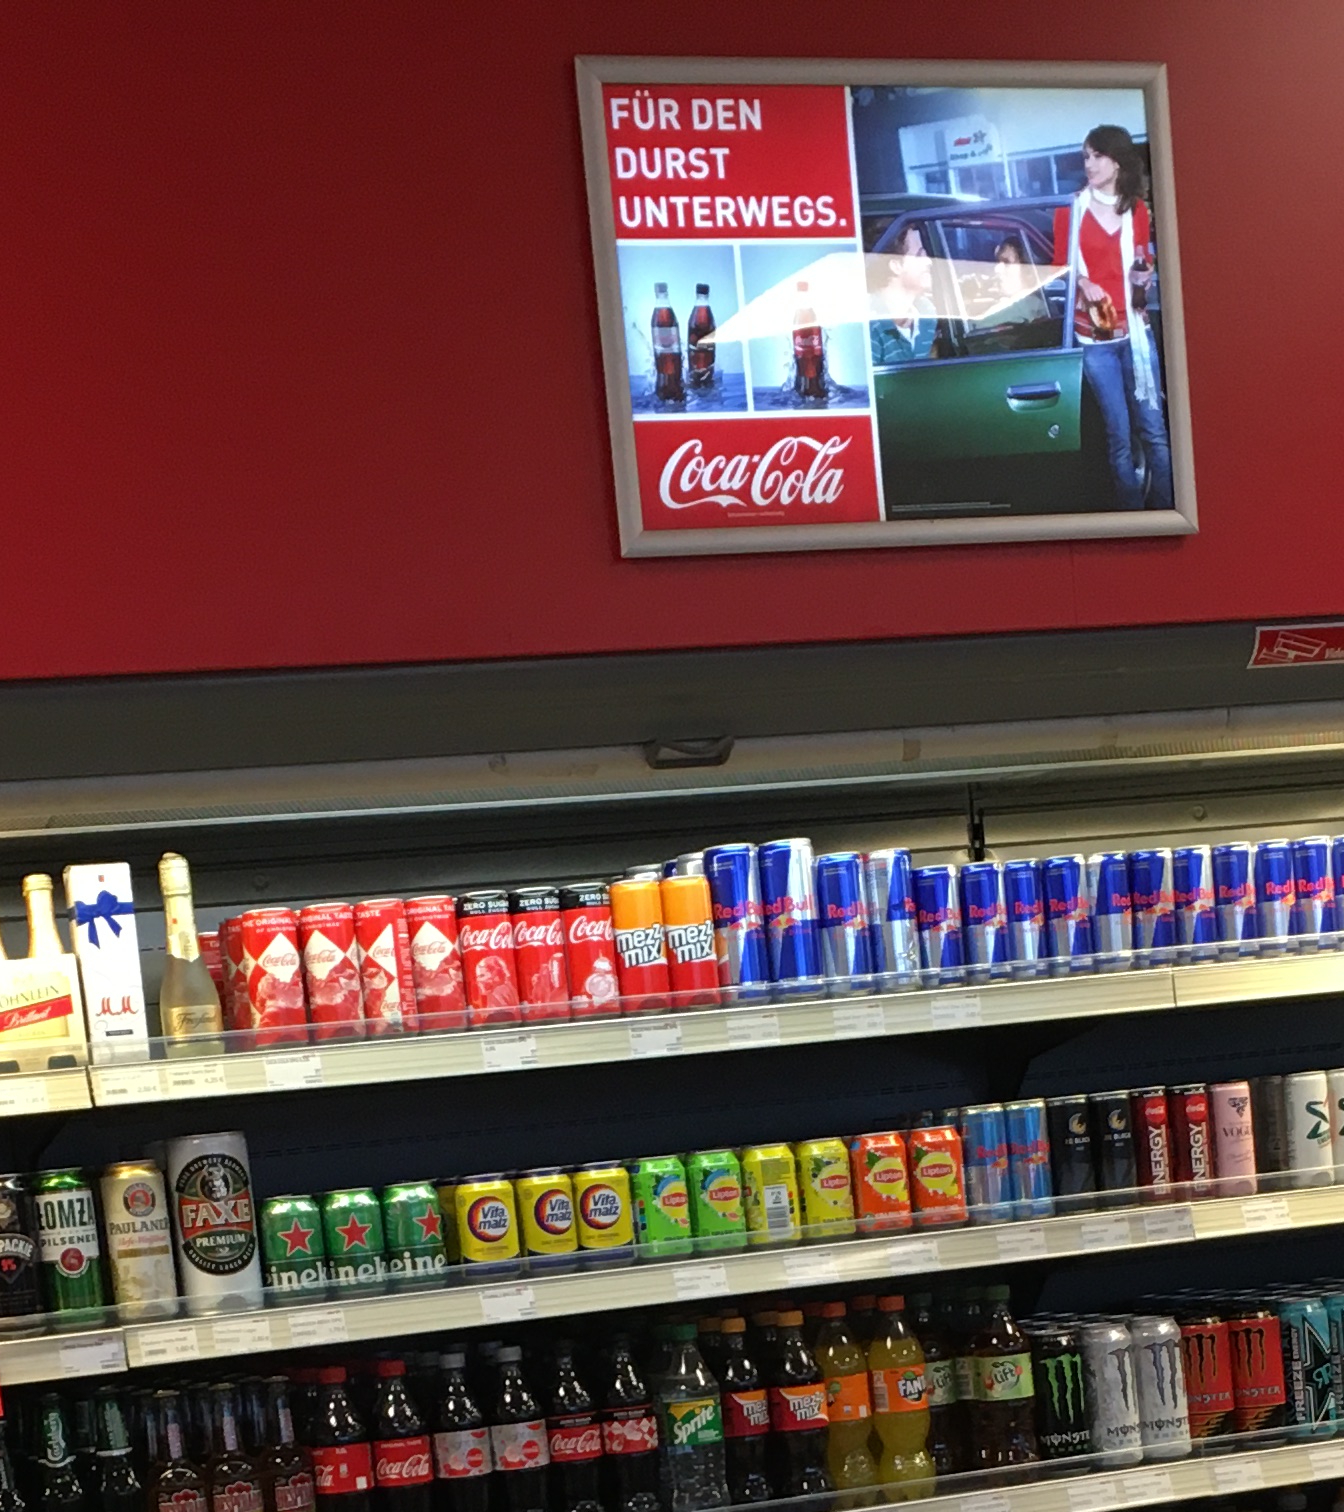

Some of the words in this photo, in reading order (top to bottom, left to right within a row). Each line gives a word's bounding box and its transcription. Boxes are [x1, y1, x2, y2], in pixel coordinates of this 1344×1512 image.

[612, 89, 681, 130] FÜR
[693, 98, 762, 130] DEN
[616, 148, 730, 180] DURST
[620, 195, 847, 228] UNTERWEGS.
[659, 435, 852, 510] Coca-Cola
[463, 902, 486, 912] ZERO
[828, 904, 854, 919] Red
[625, 943, 662, 967] mix
[676, 940, 713, 960] mix
[874, 1168, 904, 1184] Lipton
[922, 1163, 951, 1179] Lipton
[591, 1192, 616, 1207] Vita
[710, 1187, 740, 1201] Lipton
[181, 1199, 251, 1226] FAXE
[481, 1204, 505, 1219] Vita
[586, 1204, 621, 1221] malz
[478, 1215, 509, 1232] malz
[196, 1233, 246, 1248] PREMIUM
[673, 1404, 715, 1445] Sprite
[551, 1430, 601, 1456] Coca-Cola
[376, 1452, 430, 1480] Coca-Cola
